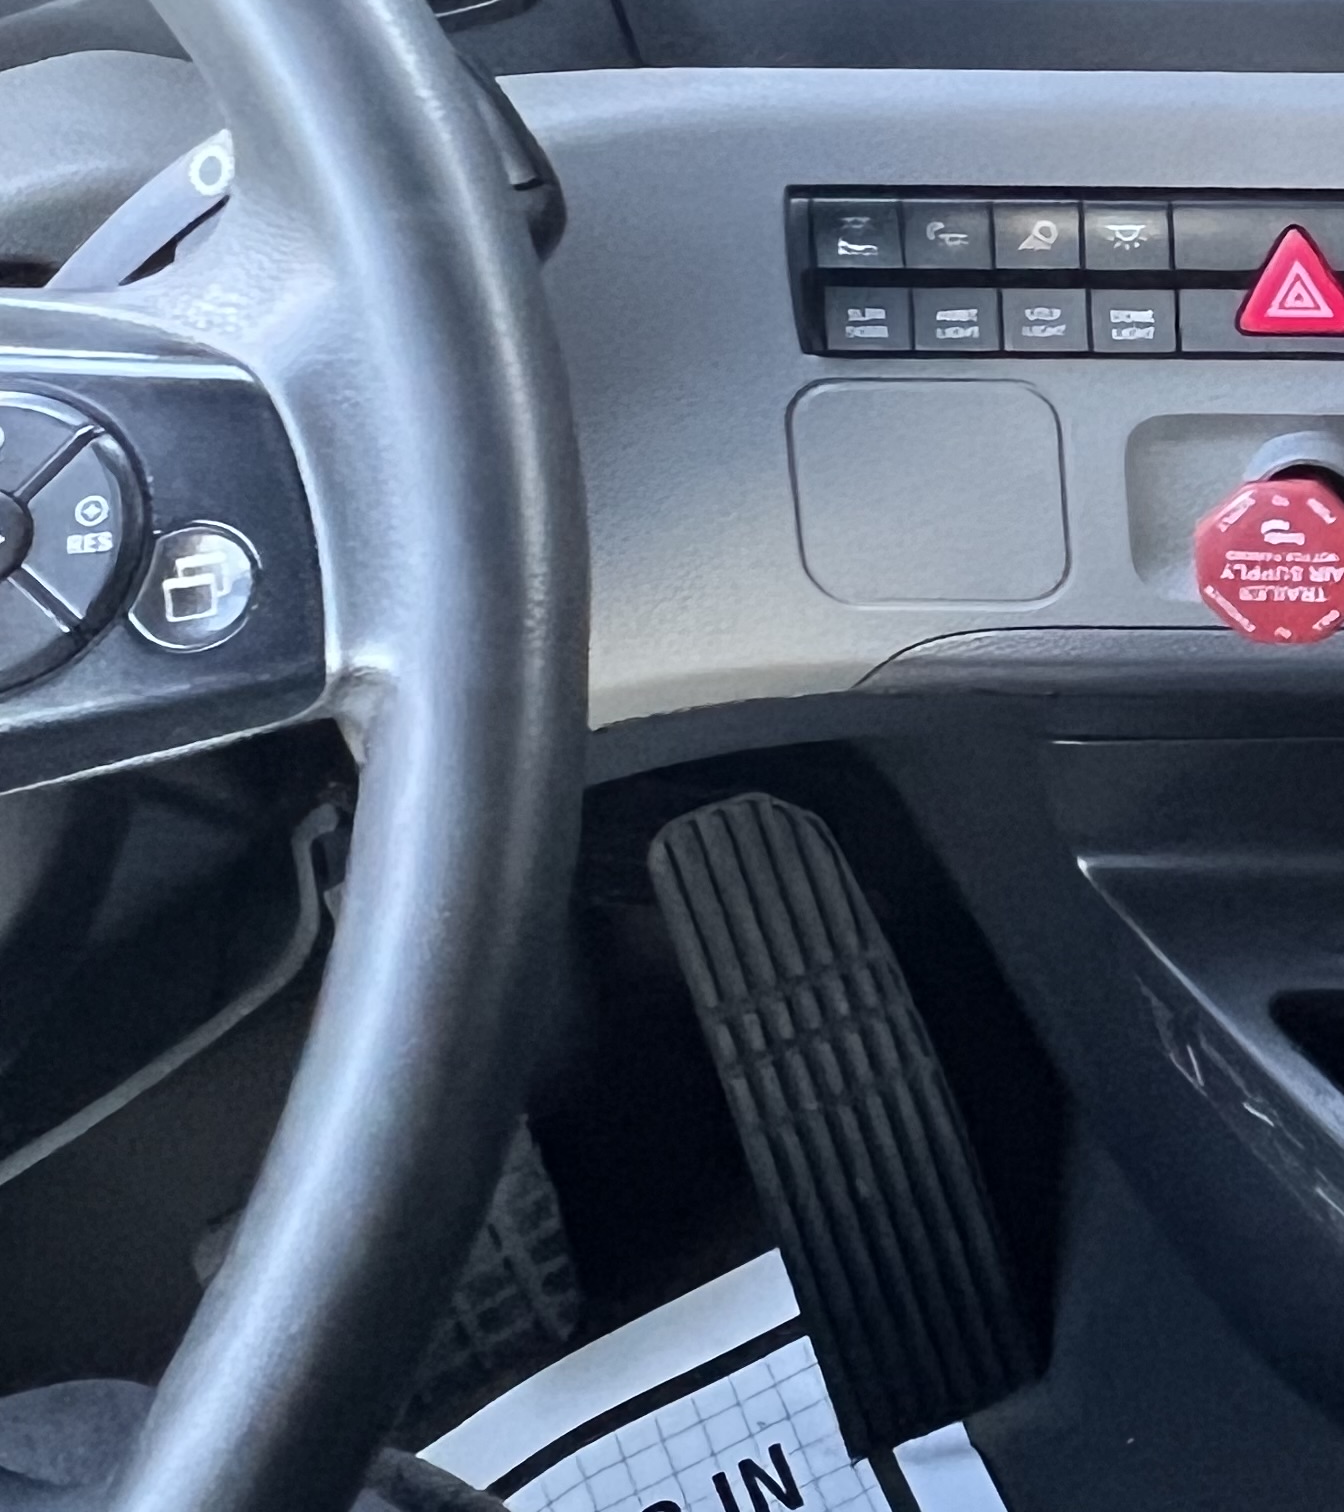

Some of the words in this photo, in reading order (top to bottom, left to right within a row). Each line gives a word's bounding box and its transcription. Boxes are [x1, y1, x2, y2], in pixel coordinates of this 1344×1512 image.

[66, 531, 114, 555] RES
[1220, 563, 1304, 582] SUPPLY
[1308, 566, 1344, 583] AIR
[711, 1442, 804, 1512] IN
